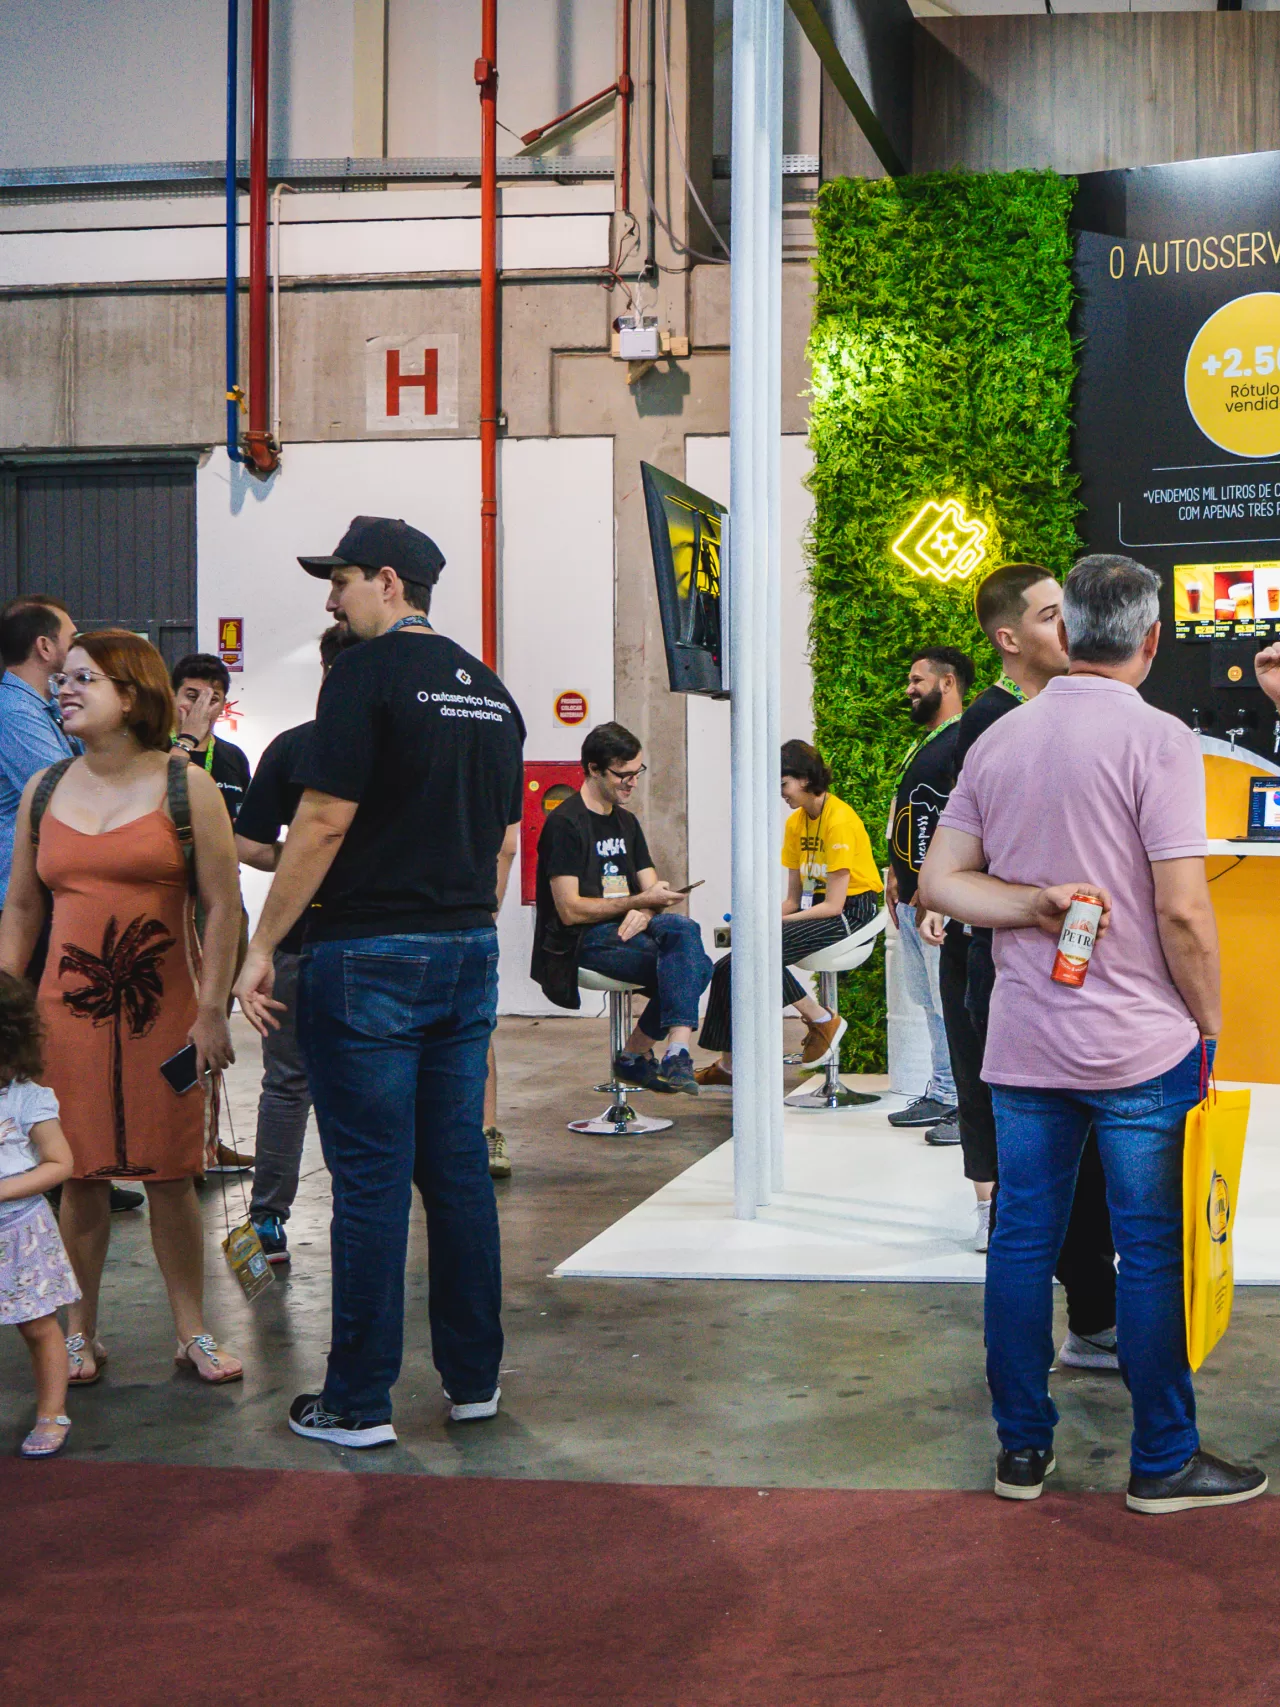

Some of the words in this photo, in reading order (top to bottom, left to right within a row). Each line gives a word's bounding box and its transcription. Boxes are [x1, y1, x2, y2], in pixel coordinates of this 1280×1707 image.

[1109, 245, 1125, 279] O
[386, 348, 438, 416] H
[1202, 486, 1218, 501] MIL
[1221, 484, 1256, 500] LITROS
[1259, 483, 1271, 498] DE
[1178, 506, 1200, 520] COM
[1203, 504, 1244, 519] APENAS
[1248, 499, 1273, 517] TRÊS
[417, 691, 429, 703] O
[431, 691, 483, 707] autosserviço
[440, 704, 457, 717] das
[457, 709, 503, 722] cervejarias
